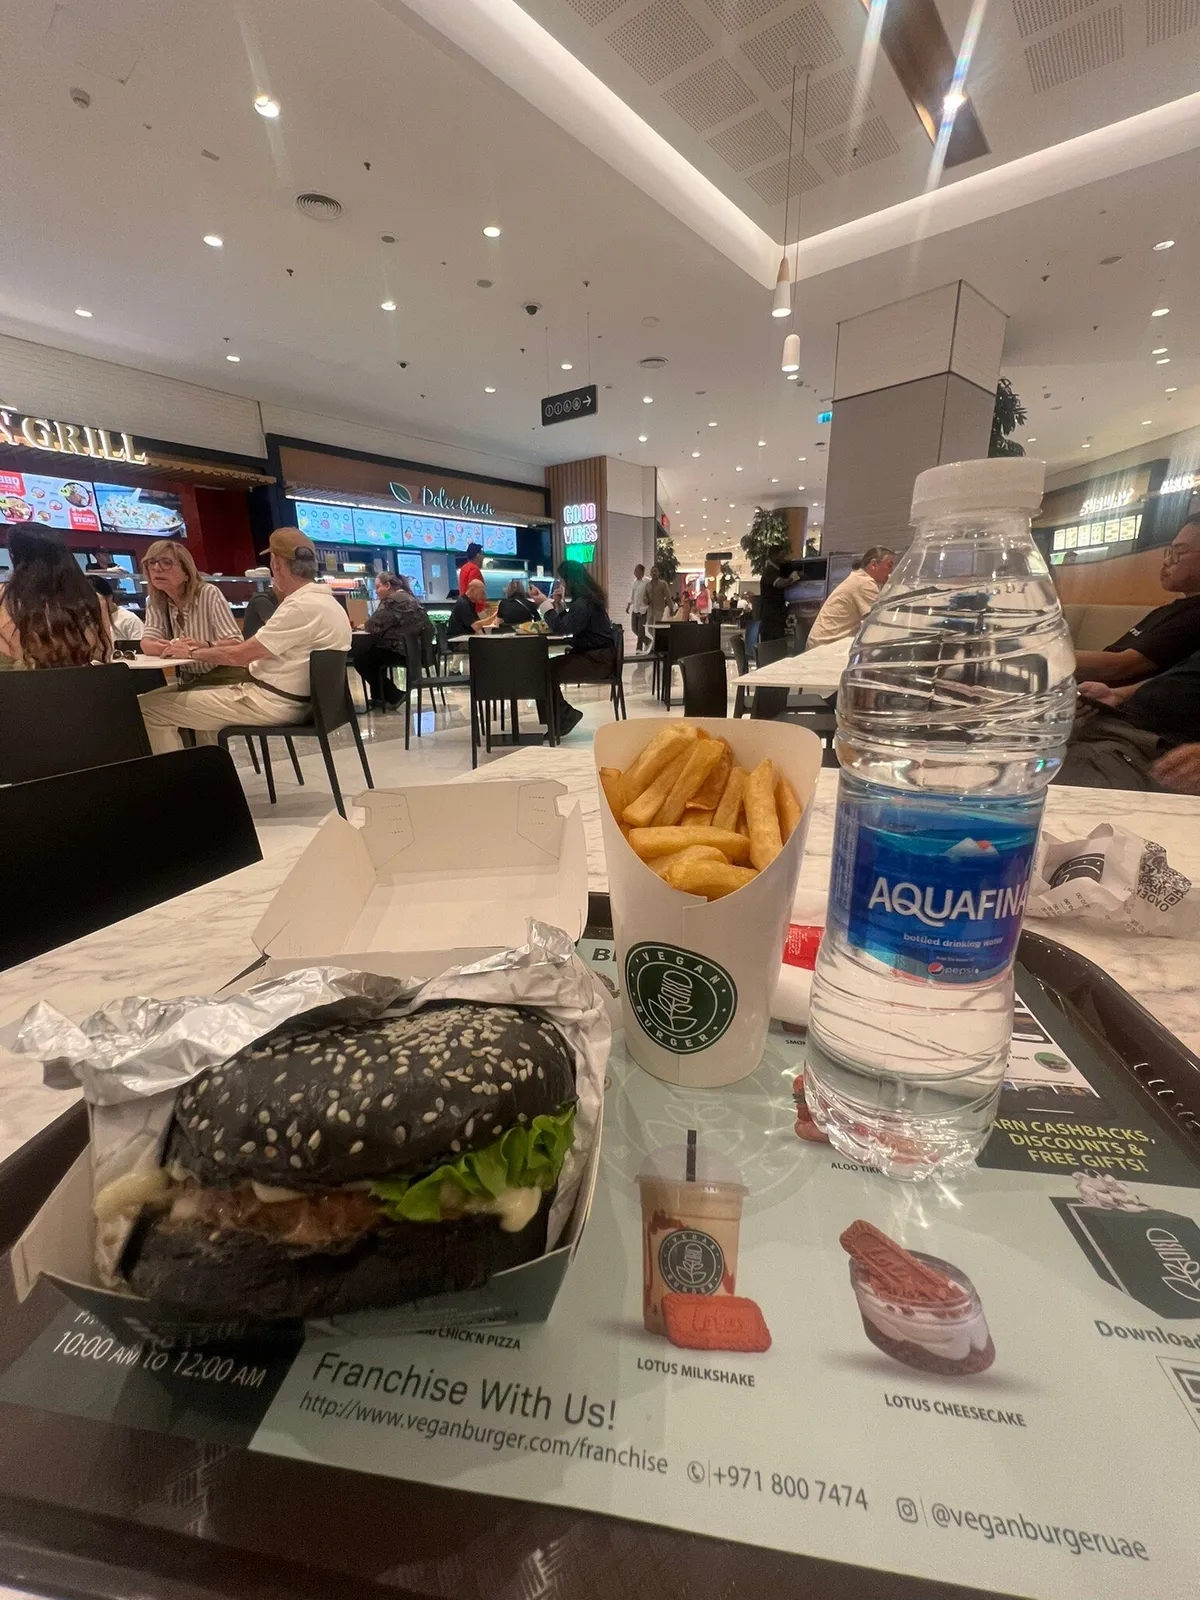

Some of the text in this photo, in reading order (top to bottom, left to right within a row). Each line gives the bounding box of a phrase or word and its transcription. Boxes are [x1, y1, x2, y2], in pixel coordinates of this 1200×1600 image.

[22, 417, 147, 466] GRILL
[563, 503, 596, 525] GOOD
[563, 523, 598, 545] VIBES
[868, 876, 1029, 928] AQUAFINA
[903, 932, 941, 946] bottled
[942, 939, 981, 949] drinking
[642, 951, 721, 984] VEGAN
[636, 1004, 710, 1048] BURGER
[992, 1118, 1156, 1145] ARN CASHBACKS,
[1009, 1133, 1147, 1157] DISCOUNTS &
[831, 1162, 858, 1171] ALOO
[1028, 1149, 1150, 1173] FREE GIFTS!
[438, 1327, 484, 1345] CHICK'N
[486, 1335, 520, 1350] PIZZA
[53, 1331, 114, 1360] 10:00
[108, 1345, 141, 1367] AM
[143, 1350, 169, 1371] to
[174, 1351, 235, 1381] 12:00
[231, 1366, 267, 1388] AM
[637, 1357, 755, 1388] LOTUS MILKSHAKE
[312, 1352, 617, 1431] Franchise With Us!
[884, 1393, 1027, 1428] LOTUS CHEESECAKE
[299, 1390, 669, 1475] http://www.veganburger.com/franchise
[713, 1465, 868, 1511] +971 800 7474
[931, 1502, 1150, 1562] @veganburgeruae
